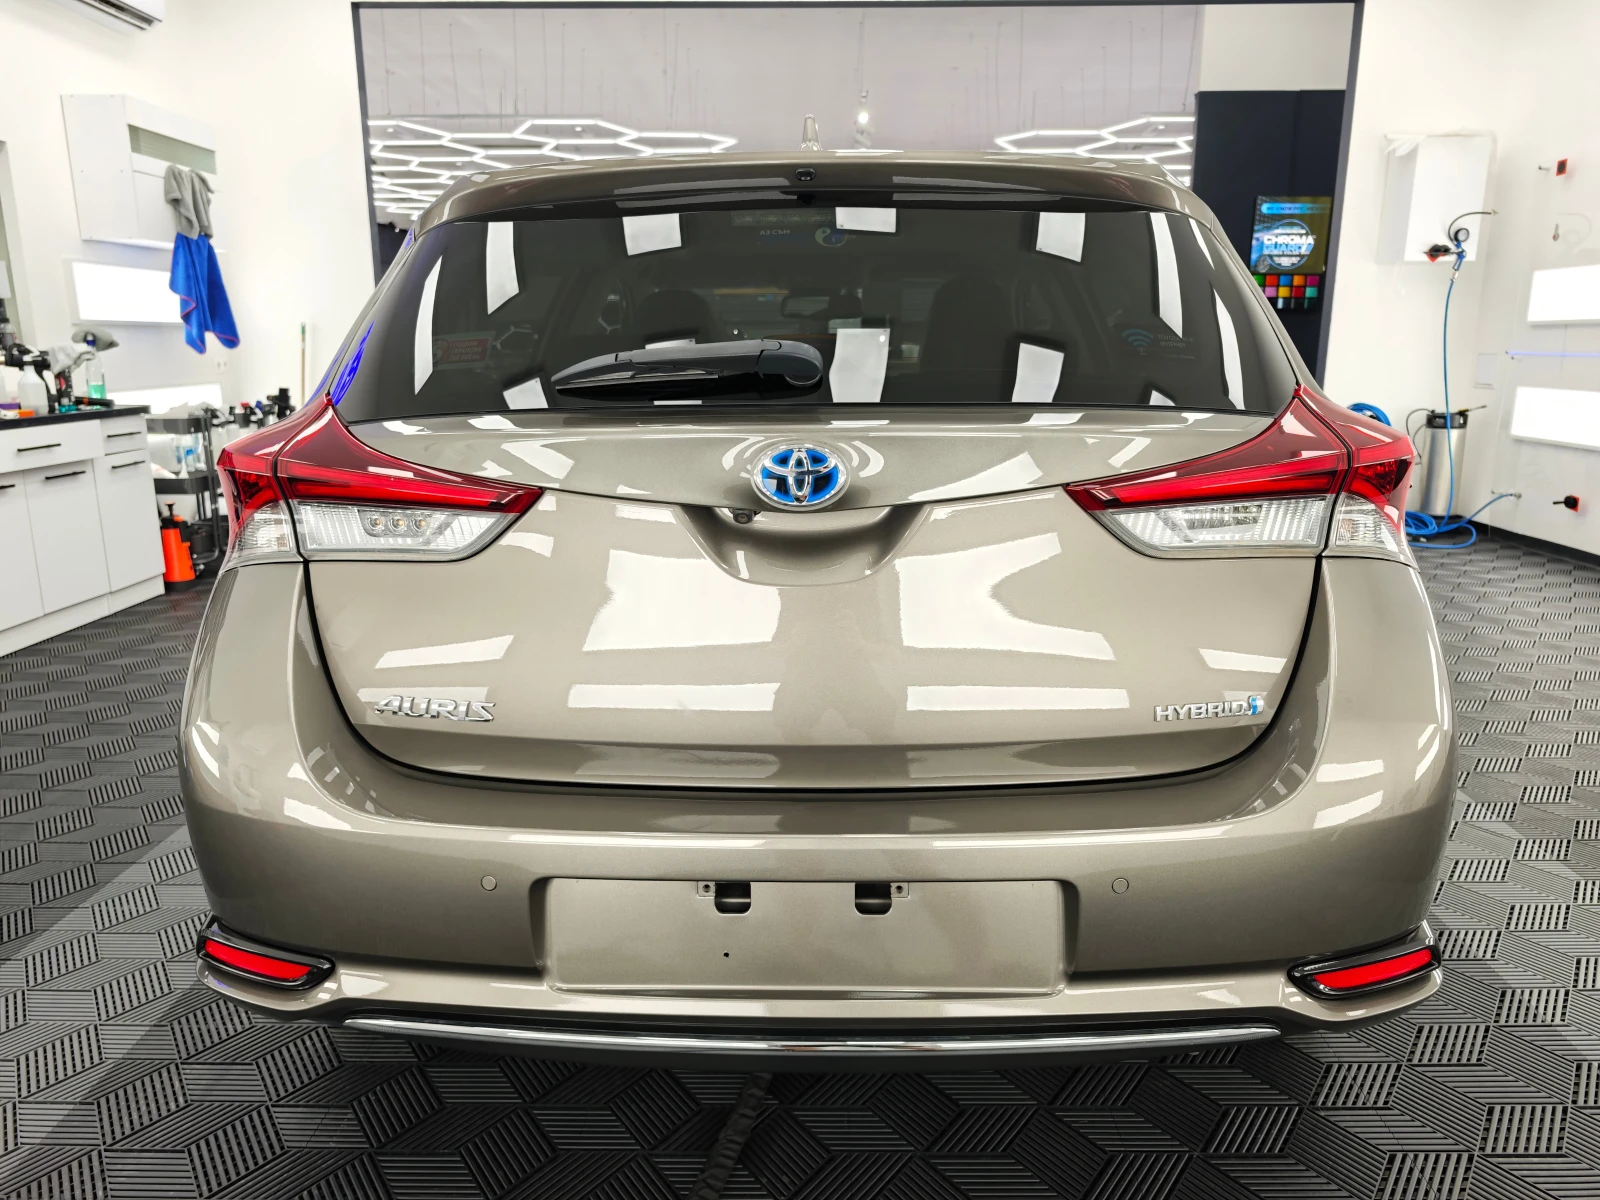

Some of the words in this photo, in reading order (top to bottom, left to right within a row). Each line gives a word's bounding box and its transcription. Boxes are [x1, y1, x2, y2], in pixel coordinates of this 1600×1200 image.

[1263, 235, 1314, 245] CHROMA
[1263, 244, 1304, 253] GUARD
[374, 694, 496, 722] AURIS
[1154, 700, 1248, 722] HYBRID
